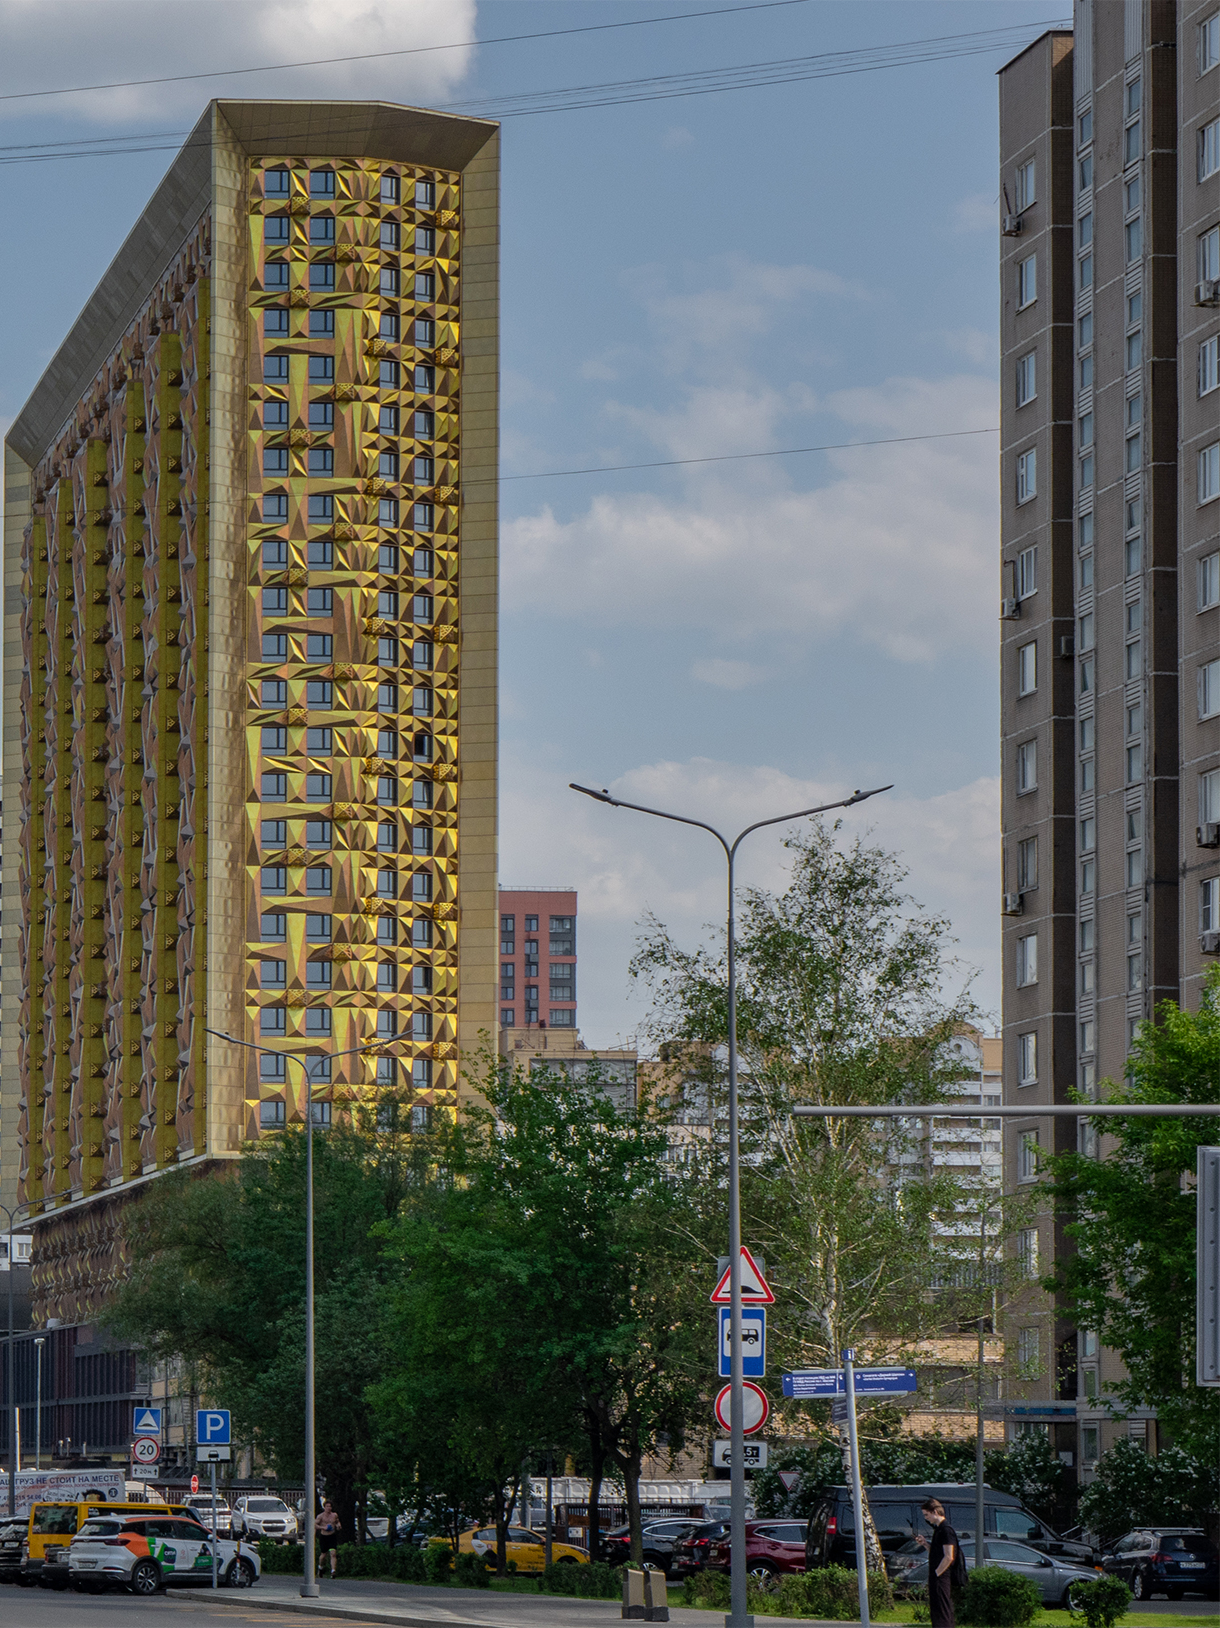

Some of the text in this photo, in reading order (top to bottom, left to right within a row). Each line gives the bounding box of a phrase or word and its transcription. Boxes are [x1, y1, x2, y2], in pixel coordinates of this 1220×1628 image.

[139, 1445, 154, 1455] 20
[49, 1476, 76, 1484] СТОИТ
[78, 1475, 90, 1483] НА
[91, 1474, 119, 1482] МЕСТЕ
